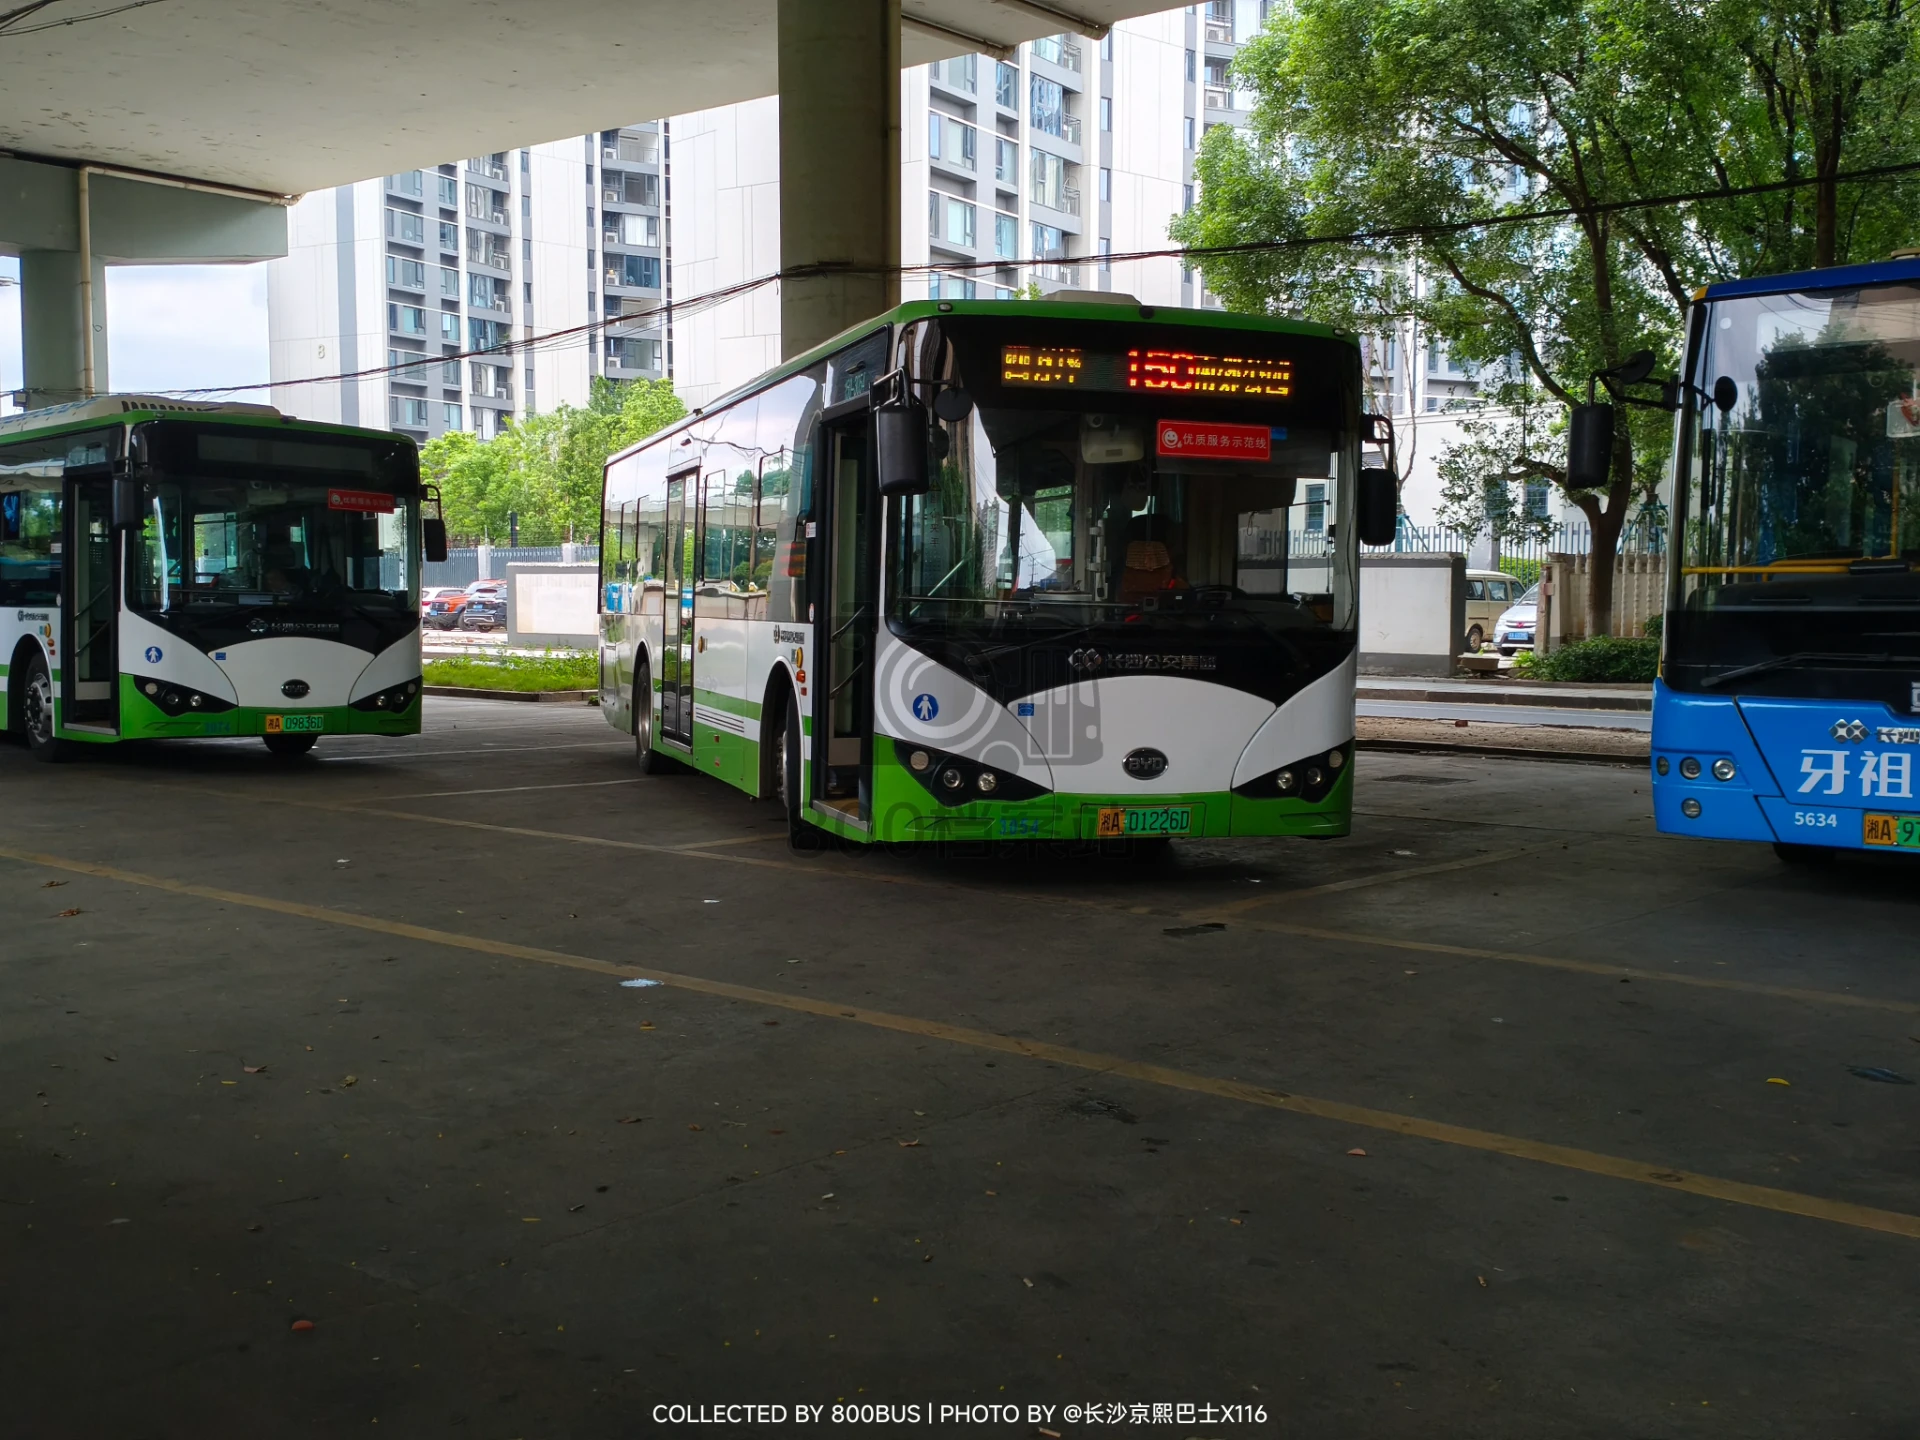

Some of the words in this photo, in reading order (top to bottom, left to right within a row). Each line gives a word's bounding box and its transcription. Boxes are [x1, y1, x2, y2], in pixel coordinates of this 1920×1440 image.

[1182, 432, 1267, 450] 优质服务示范线
[1128, 757, 1164, 771] BYD
[1796, 748, 1914, 799] 牙祖
[1794, 811, 1838, 828] 5634
